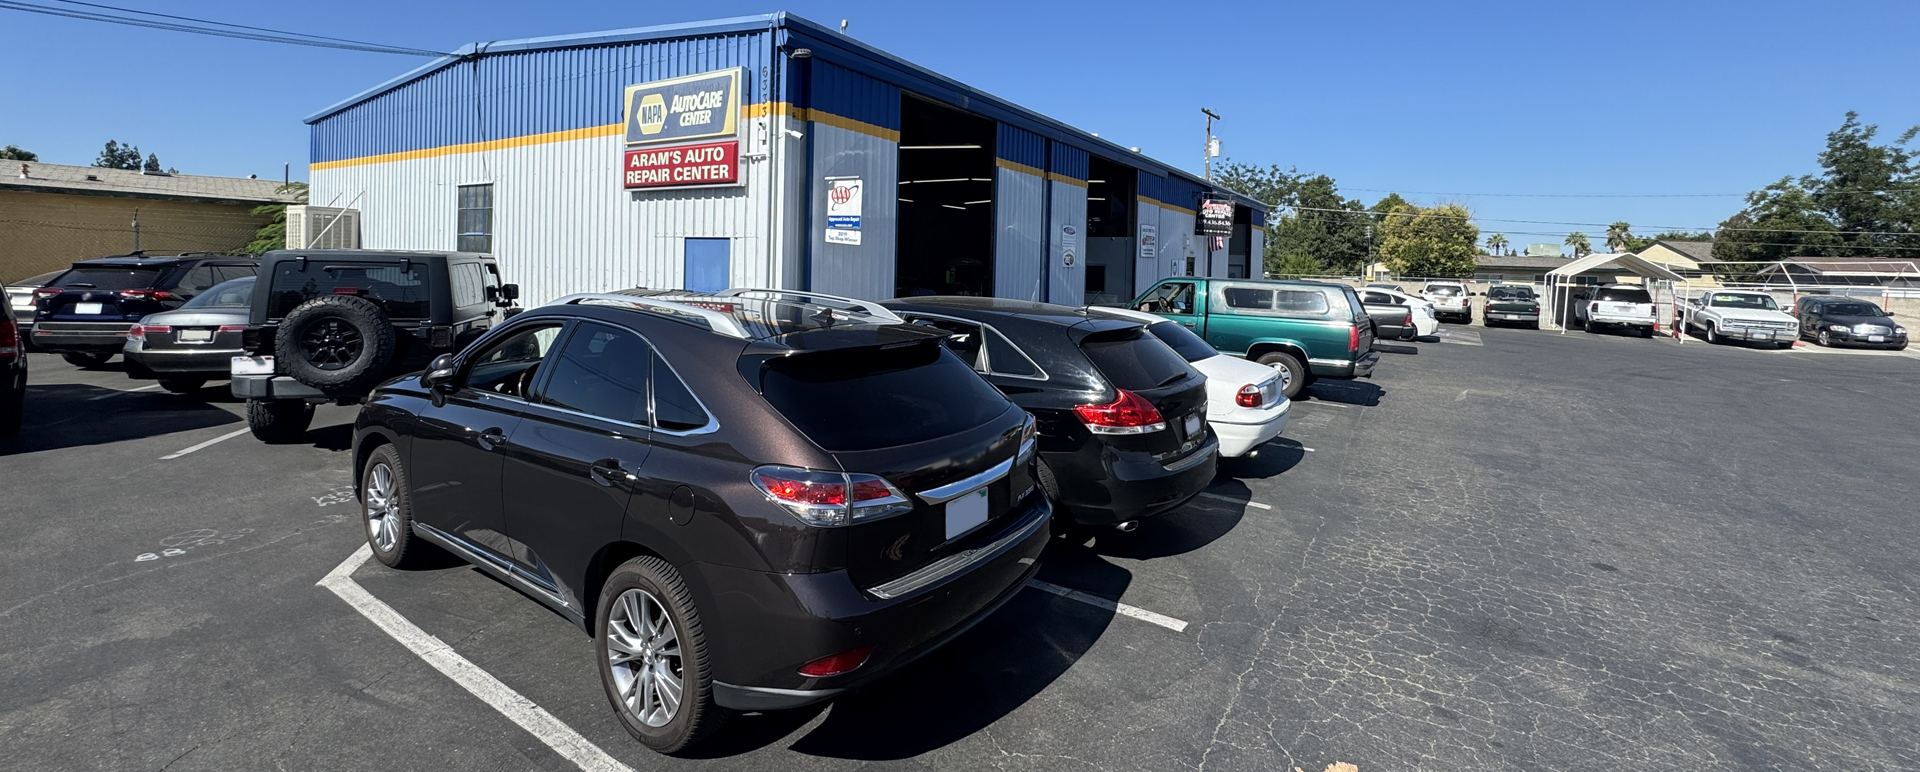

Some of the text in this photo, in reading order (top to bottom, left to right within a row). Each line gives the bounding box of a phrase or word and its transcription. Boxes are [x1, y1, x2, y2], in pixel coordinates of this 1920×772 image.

[641, 104, 662, 124] NAPA
[680, 110, 712, 127] CENTER
[630, 147, 724, 168] ARAM'S AUTO
[626, 164, 729, 184] REPAIR CENTER
[832, 186, 850, 204] AAA
